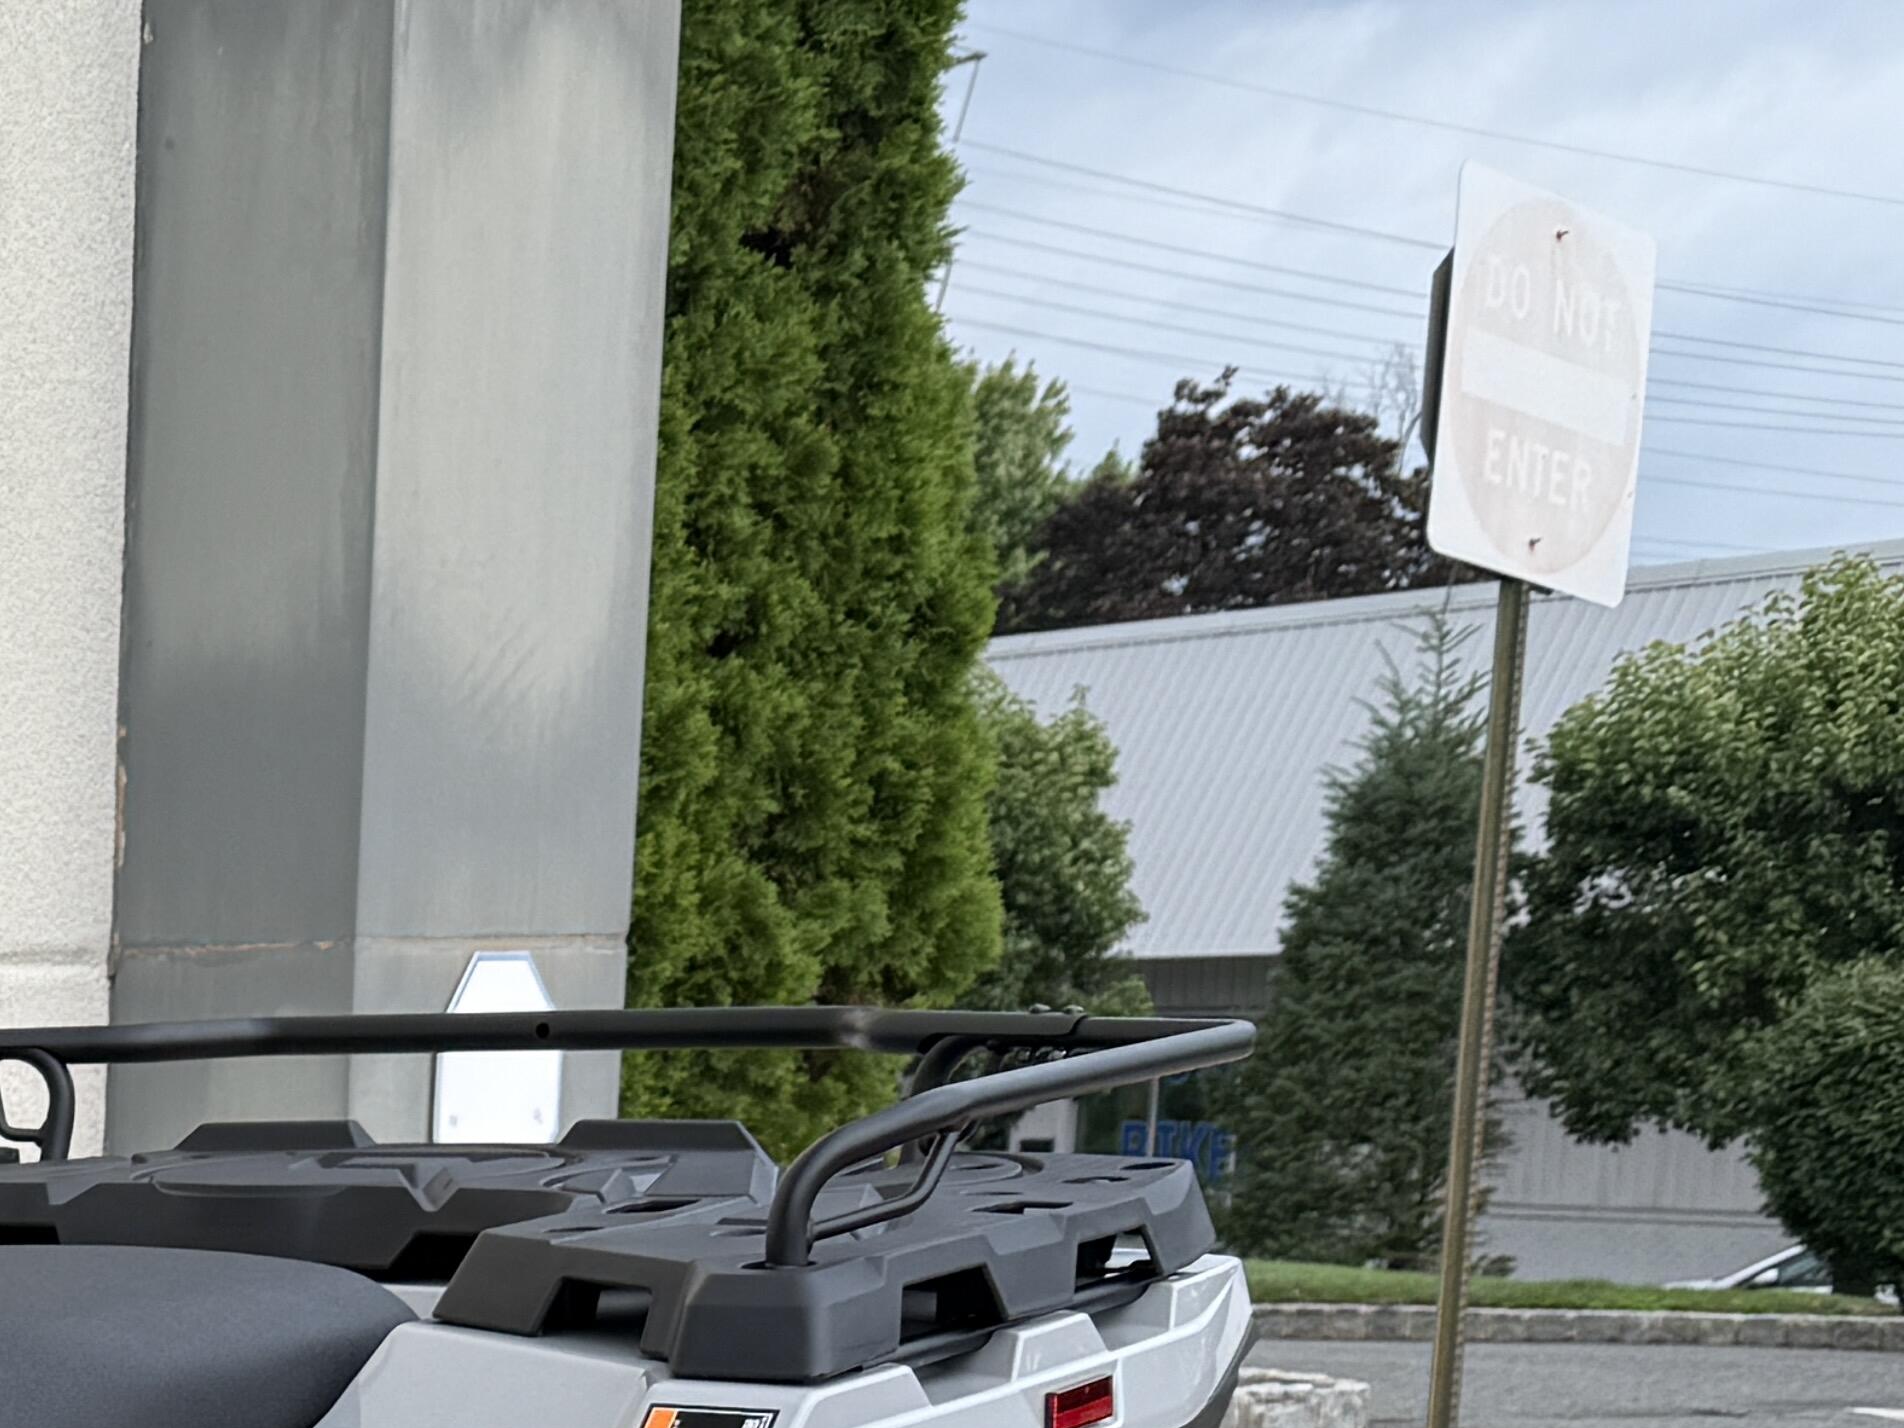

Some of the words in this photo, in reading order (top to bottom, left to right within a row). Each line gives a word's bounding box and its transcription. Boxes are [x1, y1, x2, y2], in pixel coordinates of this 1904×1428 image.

[1487, 255, 1531, 320] DO
[1553, 278, 1623, 353] NOT
[1485, 429, 1592, 508] ENTER
